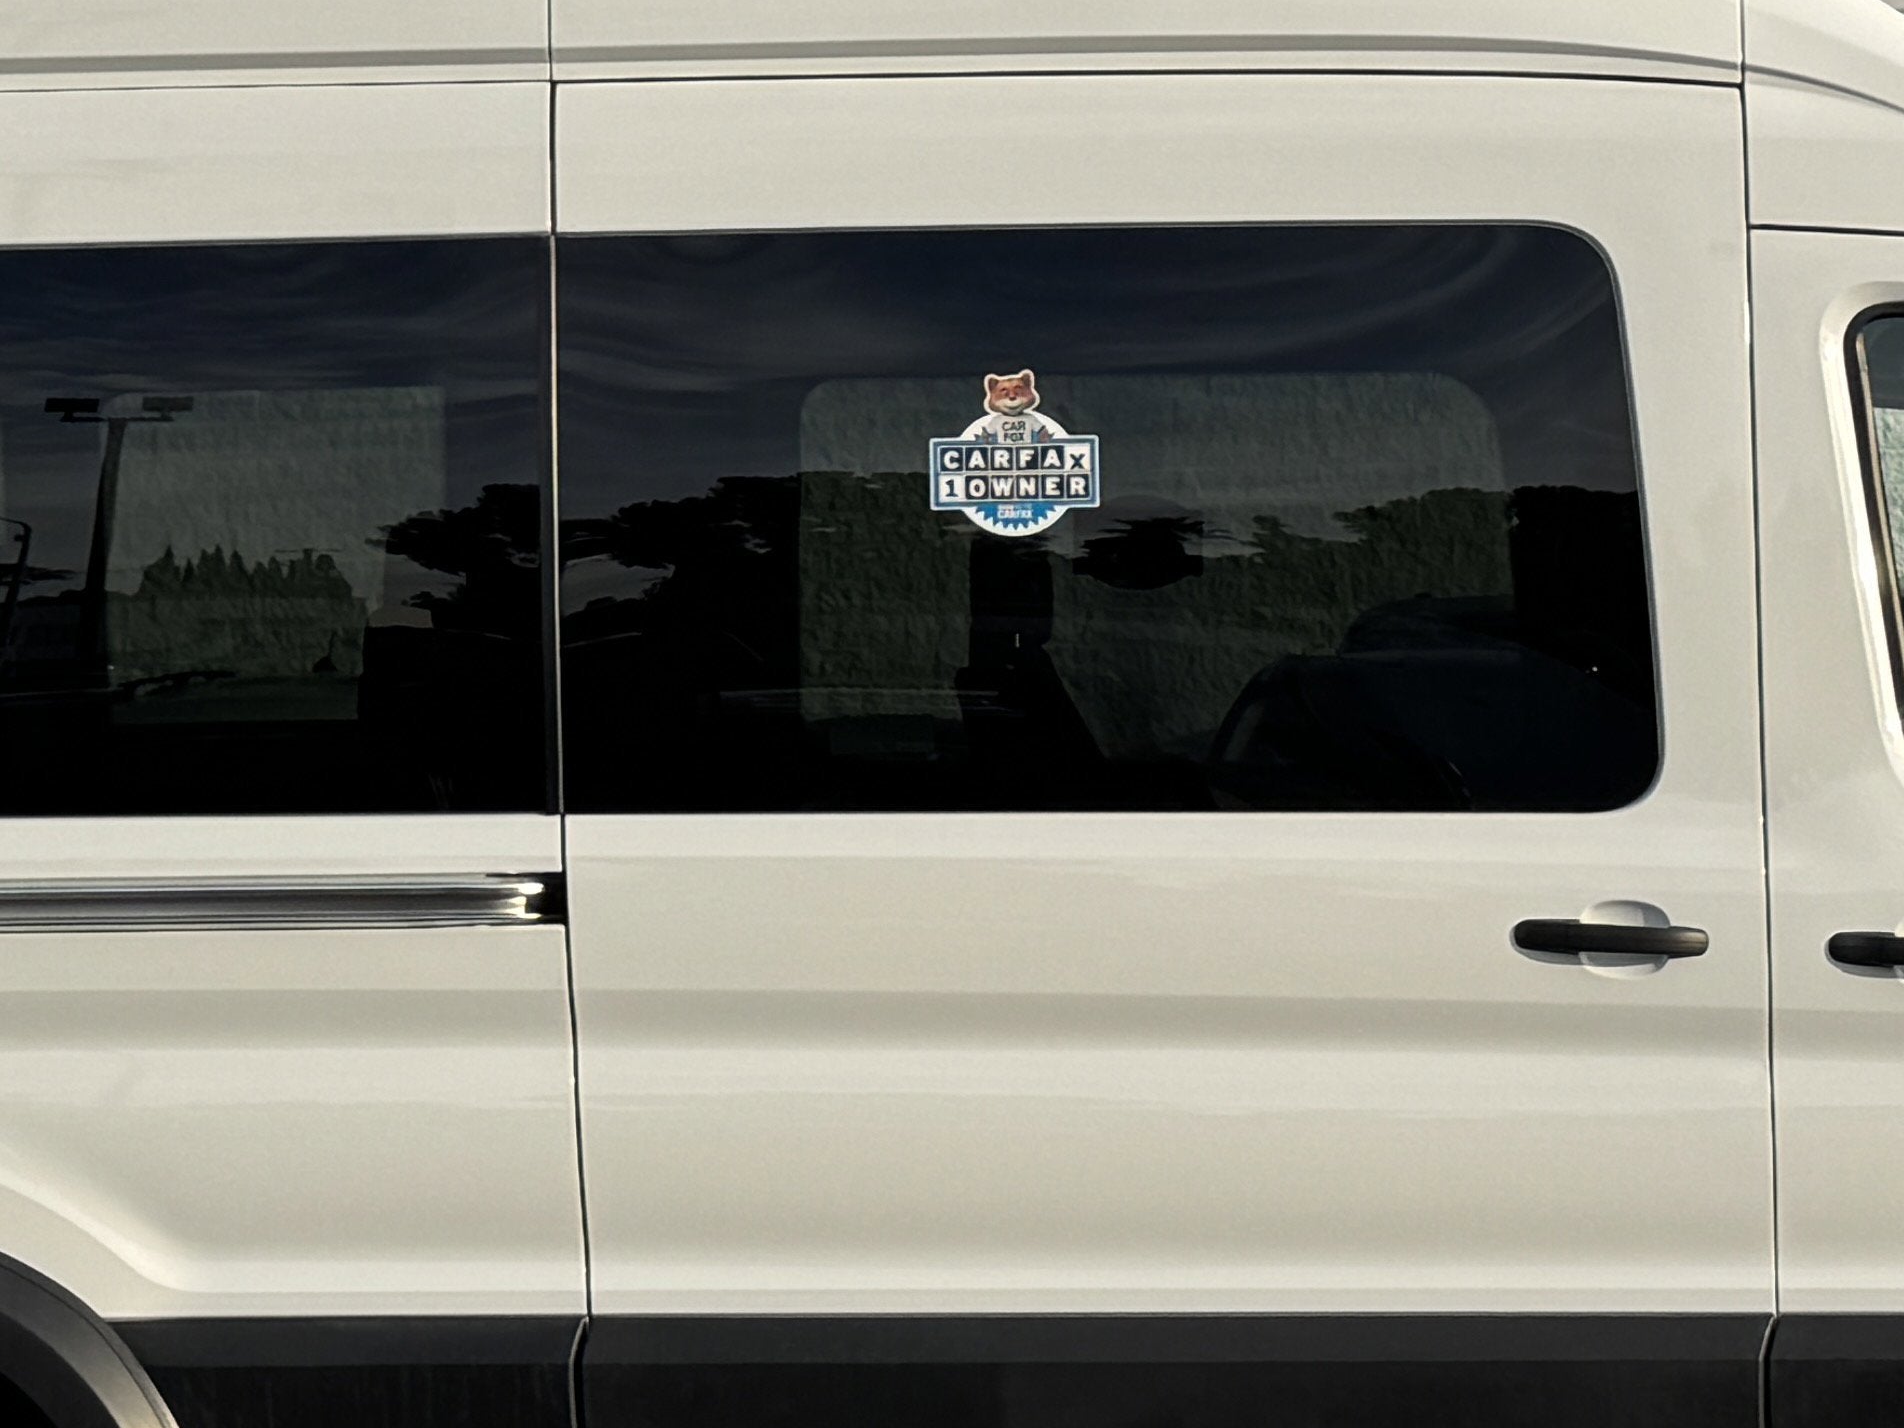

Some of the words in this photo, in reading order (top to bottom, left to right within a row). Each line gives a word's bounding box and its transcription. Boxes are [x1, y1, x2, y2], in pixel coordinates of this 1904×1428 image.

[1002, 421, 1026, 431] CAR
[1004, 432, 1025, 442] FOX
[944, 450, 1086, 469] CARFAX
[945, 480, 958, 497] 1
[969, 477, 1086, 497] OWNER
